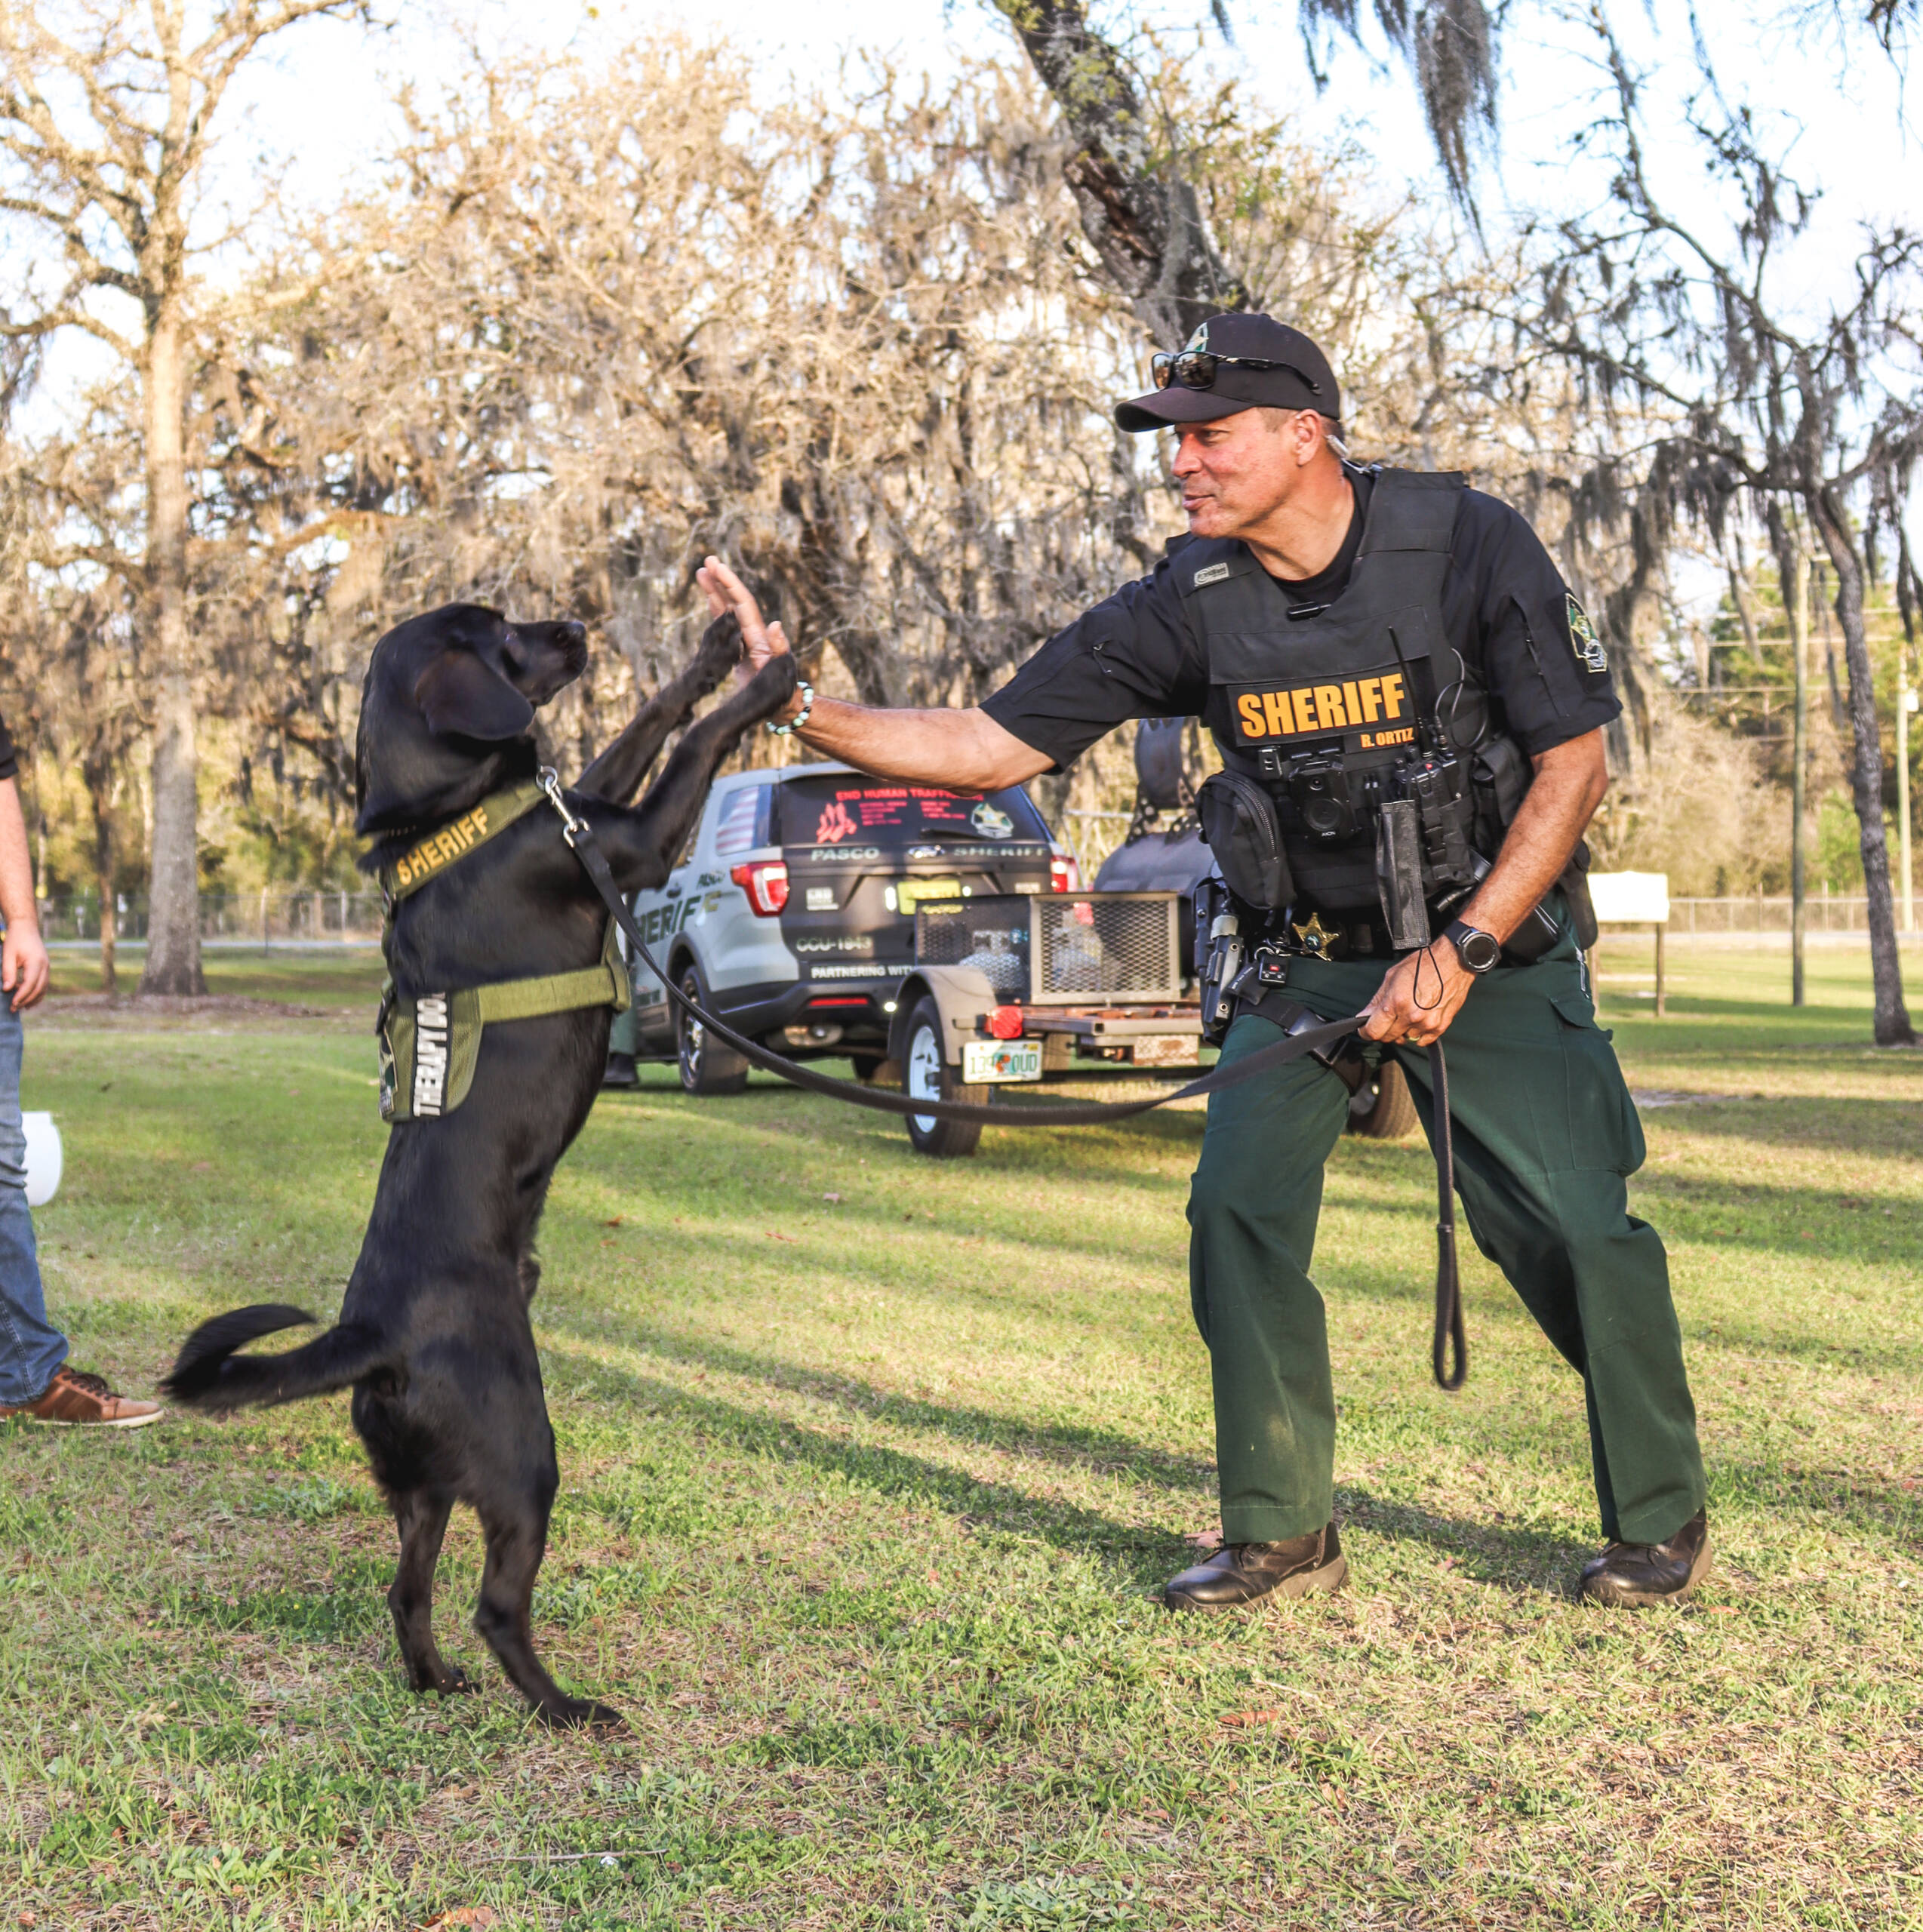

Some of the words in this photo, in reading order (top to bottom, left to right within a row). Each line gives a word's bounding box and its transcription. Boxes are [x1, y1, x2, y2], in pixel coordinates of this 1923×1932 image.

[1237, 673, 1405, 739] SHERIFF
[1360, 734, 1376, 748] R.
[1376, 728, 1415, 746] ORTIZ
[396, 805, 488, 886] SHERIFF
[811, 846, 881, 862] PASCO
[954, 846, 1046, 857] SHERIFF
[811, 965, 886, 979] PARTNERING
[416, 992, 448, 1028] DO
[413, 1026, 448, 1117] THERAPY
